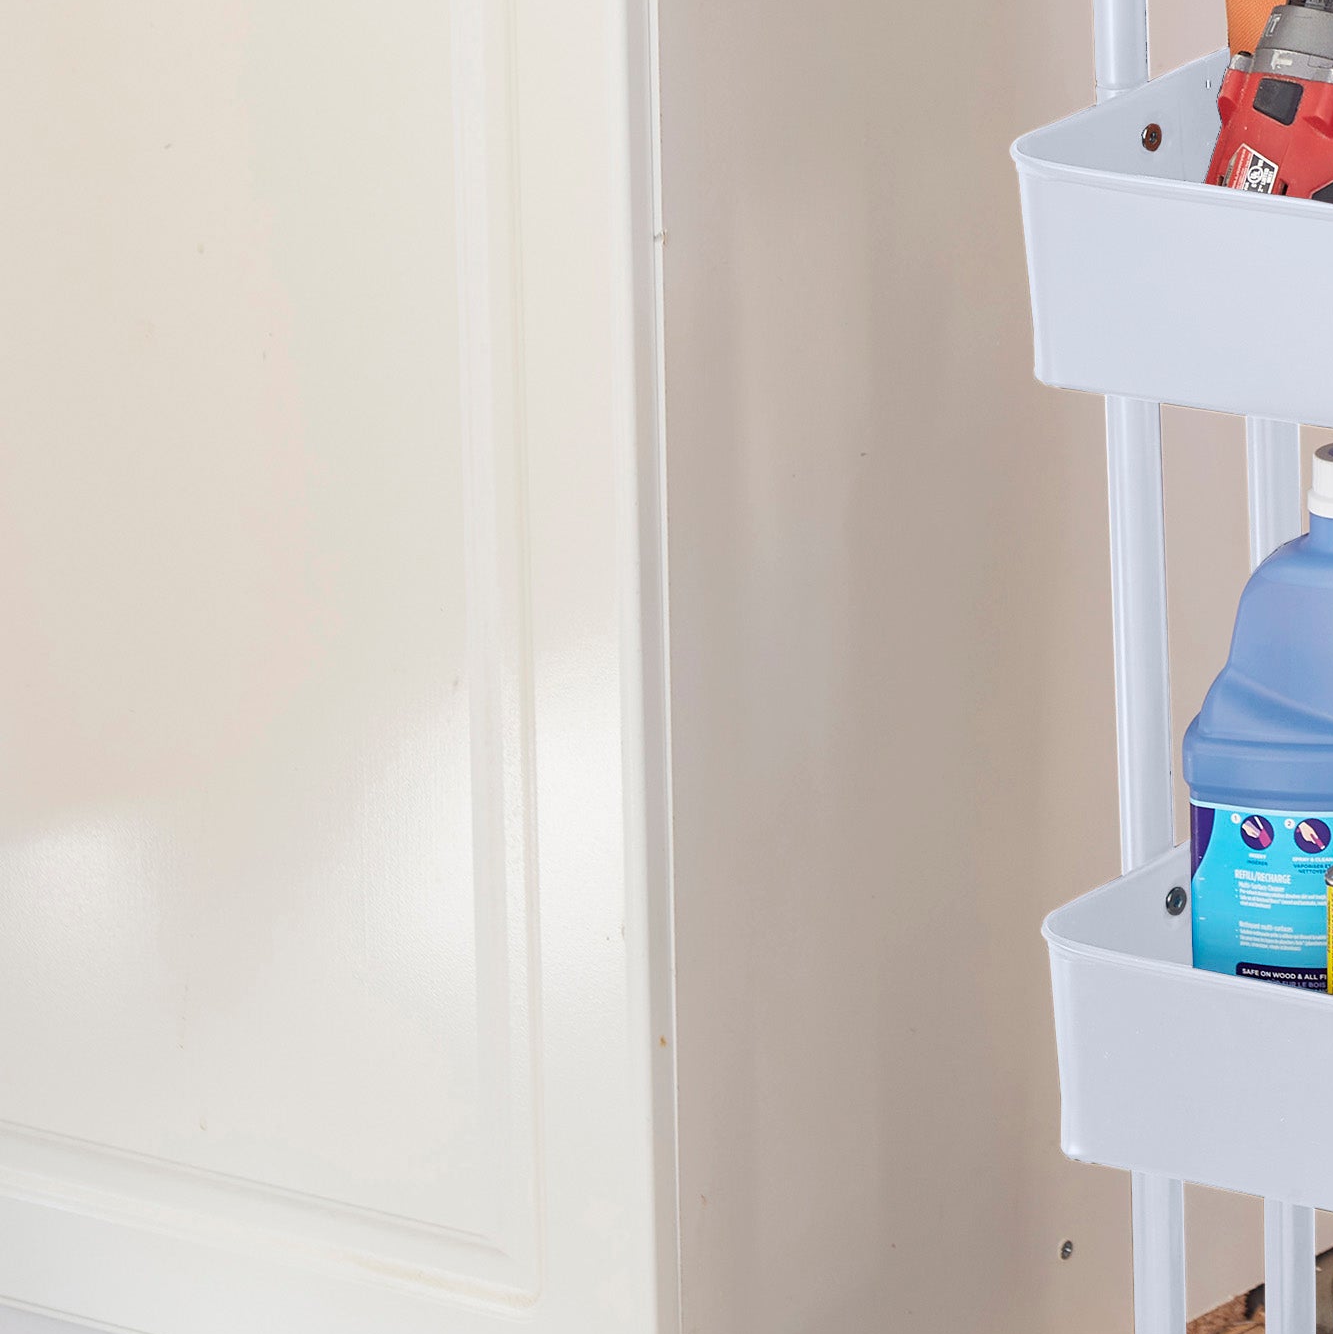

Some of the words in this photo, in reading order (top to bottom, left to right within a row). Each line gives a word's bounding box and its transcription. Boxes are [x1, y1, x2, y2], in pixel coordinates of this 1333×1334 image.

[1234, 868, 1292, 885] REFILL/RECHARGE
[1241, 968, 1260, 977] SAFE
[1260, 970, 1272, 978] ON
[1272, 971, 1296, 980] WOOD
